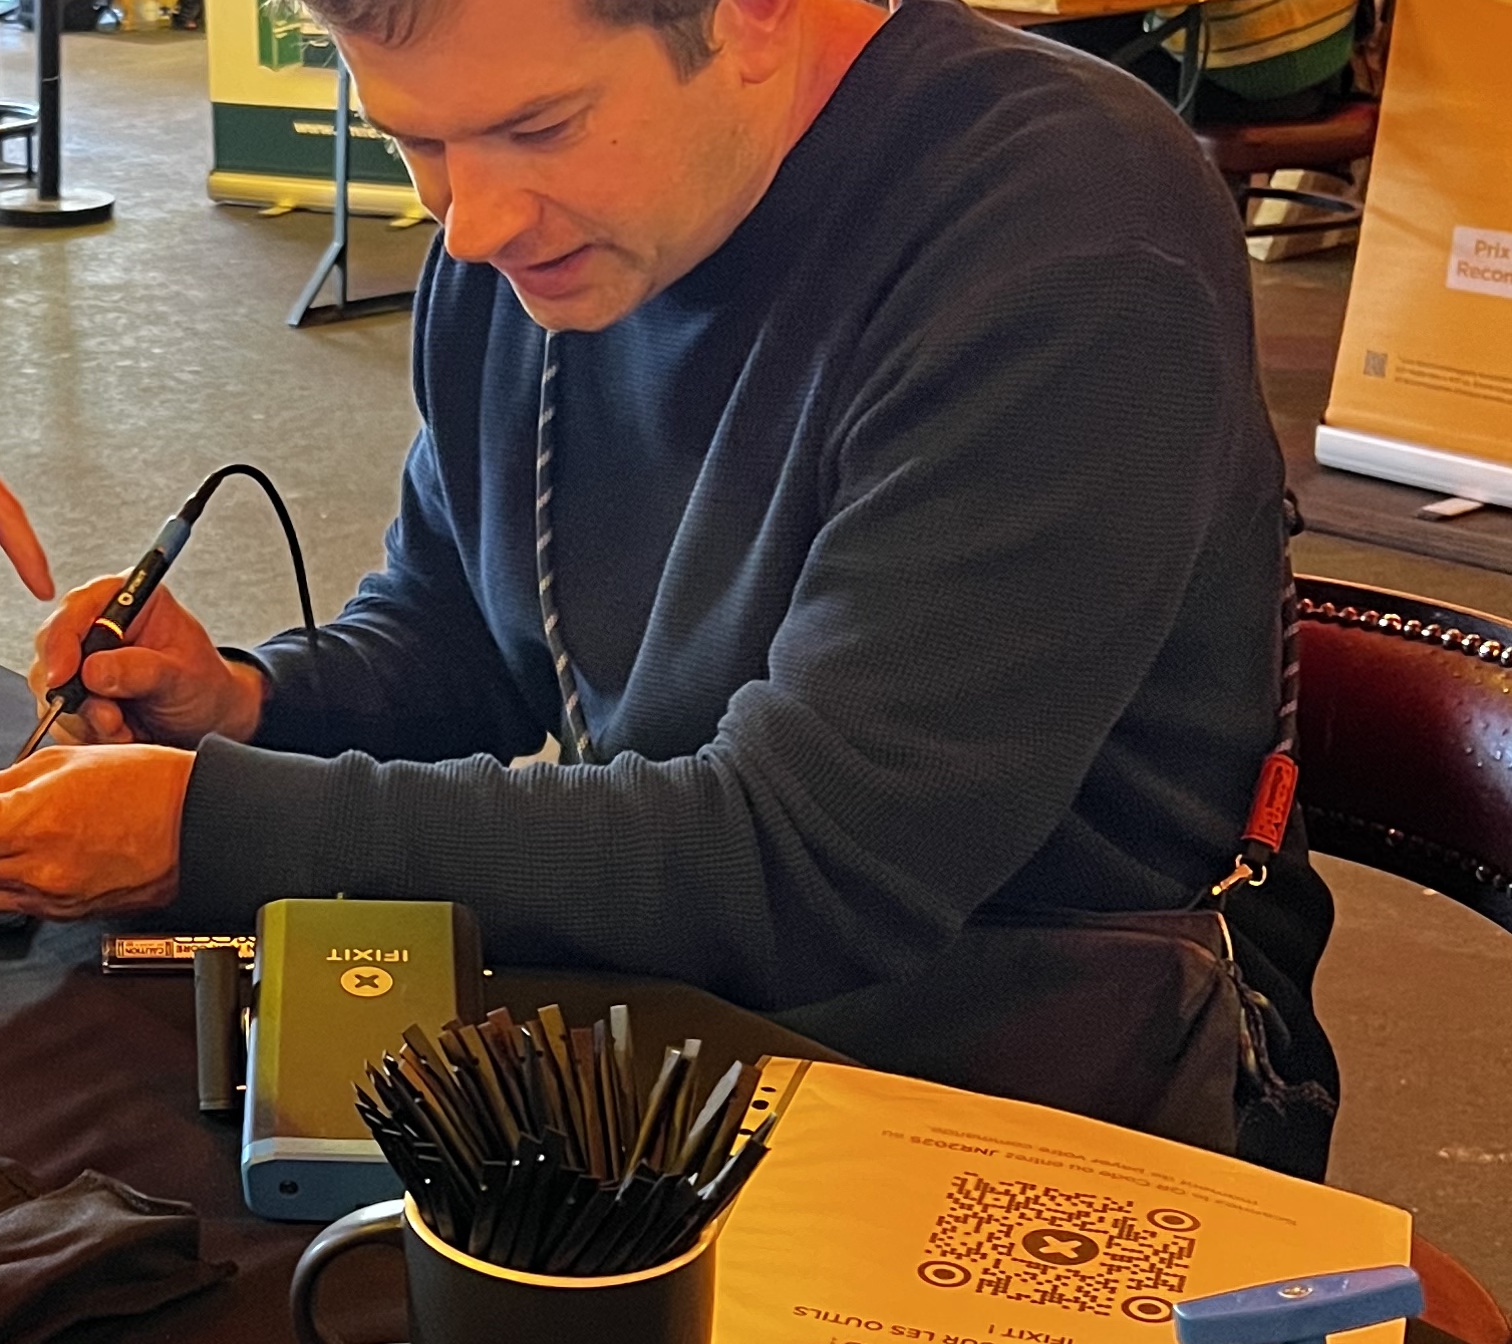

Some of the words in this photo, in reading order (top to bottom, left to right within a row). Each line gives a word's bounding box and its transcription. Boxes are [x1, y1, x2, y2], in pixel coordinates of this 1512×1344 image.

[1475, 240, 1510, 259] Prix
[125, 946, 163, 954] CAUTION
[327, 948, 409, 963] IFIXIT
[791, 1303, 883, 1334] OUTILS
[889, 1322, 935, 1343] LES
